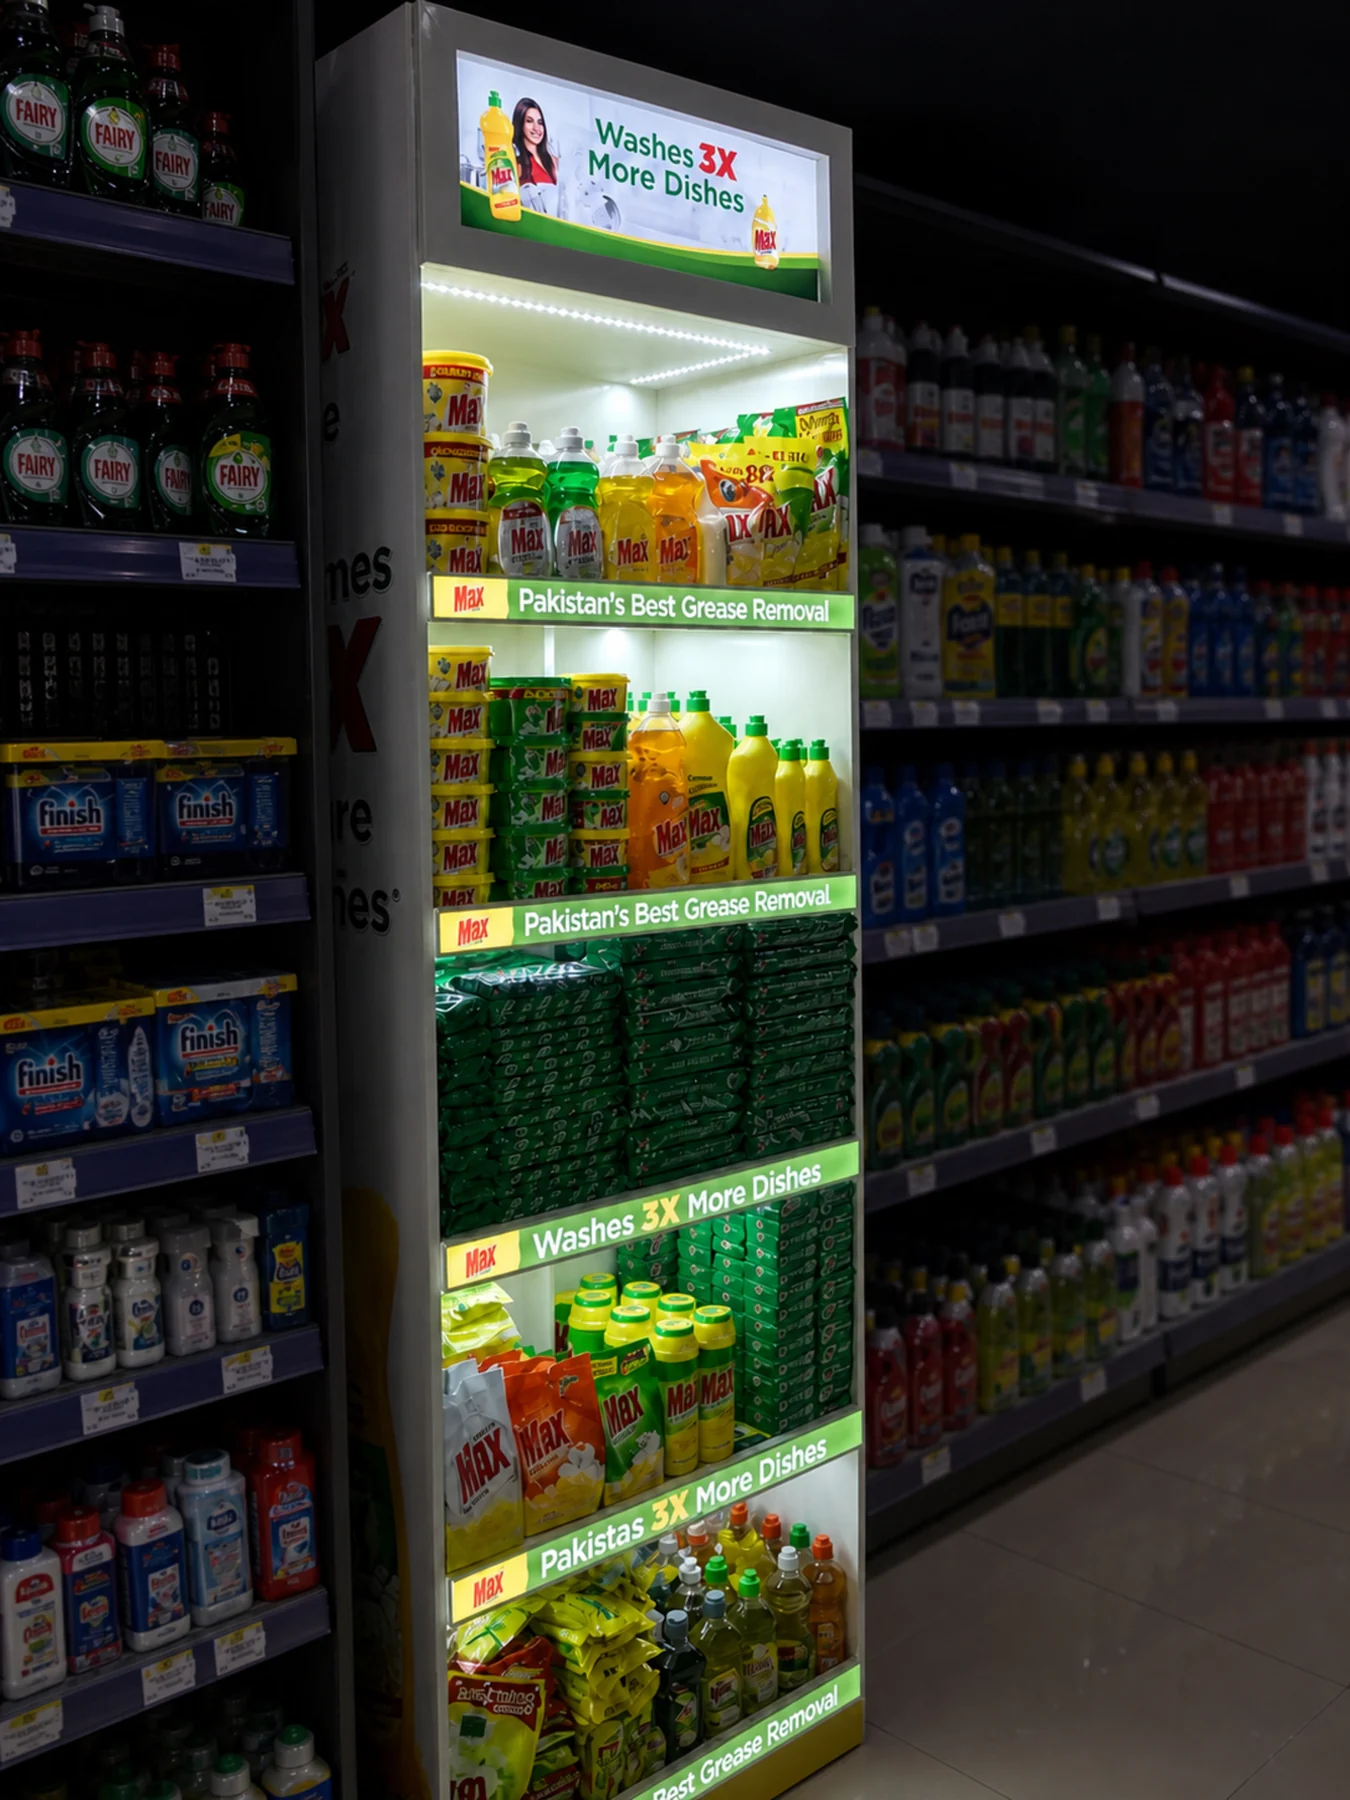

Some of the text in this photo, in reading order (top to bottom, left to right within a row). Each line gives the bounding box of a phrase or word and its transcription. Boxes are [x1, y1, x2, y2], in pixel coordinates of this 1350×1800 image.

[15, 98, 57, 129] FAIRY
[95, 123, 135, 151] FAIRY
[594, 117, 738, 182] Washes 3X
[155, 150, 191, 177] FAIRY
[588, 149, 745, 213] More Dishes
[203, 201, 235, 223] FAIRY
[754, 228, 777, 252] Max
[18, 453, 55, 477] FAIRY
[94, 458, 131, 483] FAIRY
[165, 467, 193, 491] FAIRY
[219, 464, 260, 488] FAIRY
[510, 528, 544, 555] Max
[567, 530, 597, 557] Max
[617, 537, 649, 567] Max
[449, 548, 483, 573] Max
[453, 585, 485, 613] Max
[519, 588, 829, 622] Pakistan's Best Grease Removal
[456, 660, 487, 690] Max
[587, 688, 617, 711] Max
[447, 707, 482, 734] Max
[582, 728, 612, 751] Max
[444, 753, 480, 782] Max
[591, 765, 621, 789] Max
[39, 798, 102, 828] finish
[178, 794, 235, 822] finish
[443, 799, 479, 828] Max
[656, 819, 687, 855] Max
[688, 807, 721, 839] Max
[443, 843, 477, 872] Max
[590, 843, 620, 867] Max
[442, 888, 476, 907] Max
[524, 884, 832, 937] Pakistan's Best Grease Removal
[458, 917, 490, 947] Max
[180, 1021, 239, 1052] finish
[18, 1053, 81, 1087] finish
[533, 1161, 822, 1259] Washes 3X More Dishes
[465, 1244, 497, 1280] Max
[701, 1367, 735, 1405] Max
[541, 1438, 827, 1579] Pakistas 3X More Dishes
[473, 1571, 504, 1609] Max
[652, 1684, 838, 1800] Best Grease Removal
